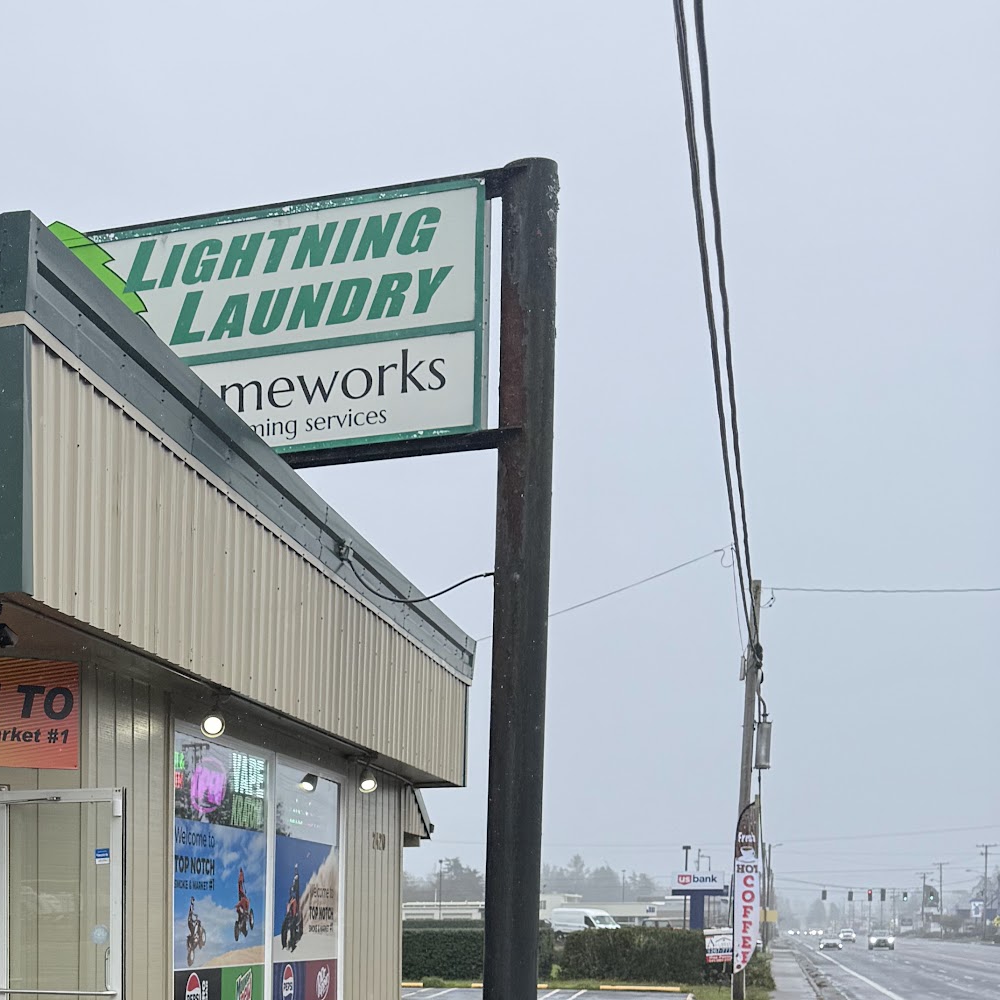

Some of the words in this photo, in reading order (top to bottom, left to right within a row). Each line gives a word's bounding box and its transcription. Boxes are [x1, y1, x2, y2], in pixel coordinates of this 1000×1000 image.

[123, 206, 442, 293] LIGHTNING
[170, 265, 453, 346] LAUNDRY
[220, 349, 446, 413] meworks
[305, 409, 387, 433] services
[17, 684, 74, 720] TO
[47, 728, 69, 744] #1
[175, 826, 207, 847] Welcome
[208, 832, 215, 848] to
[175, 855, 190, 873] TOP
[191, 857, 215, 876] NOTCH
[693, 874, 717, 883] bank
